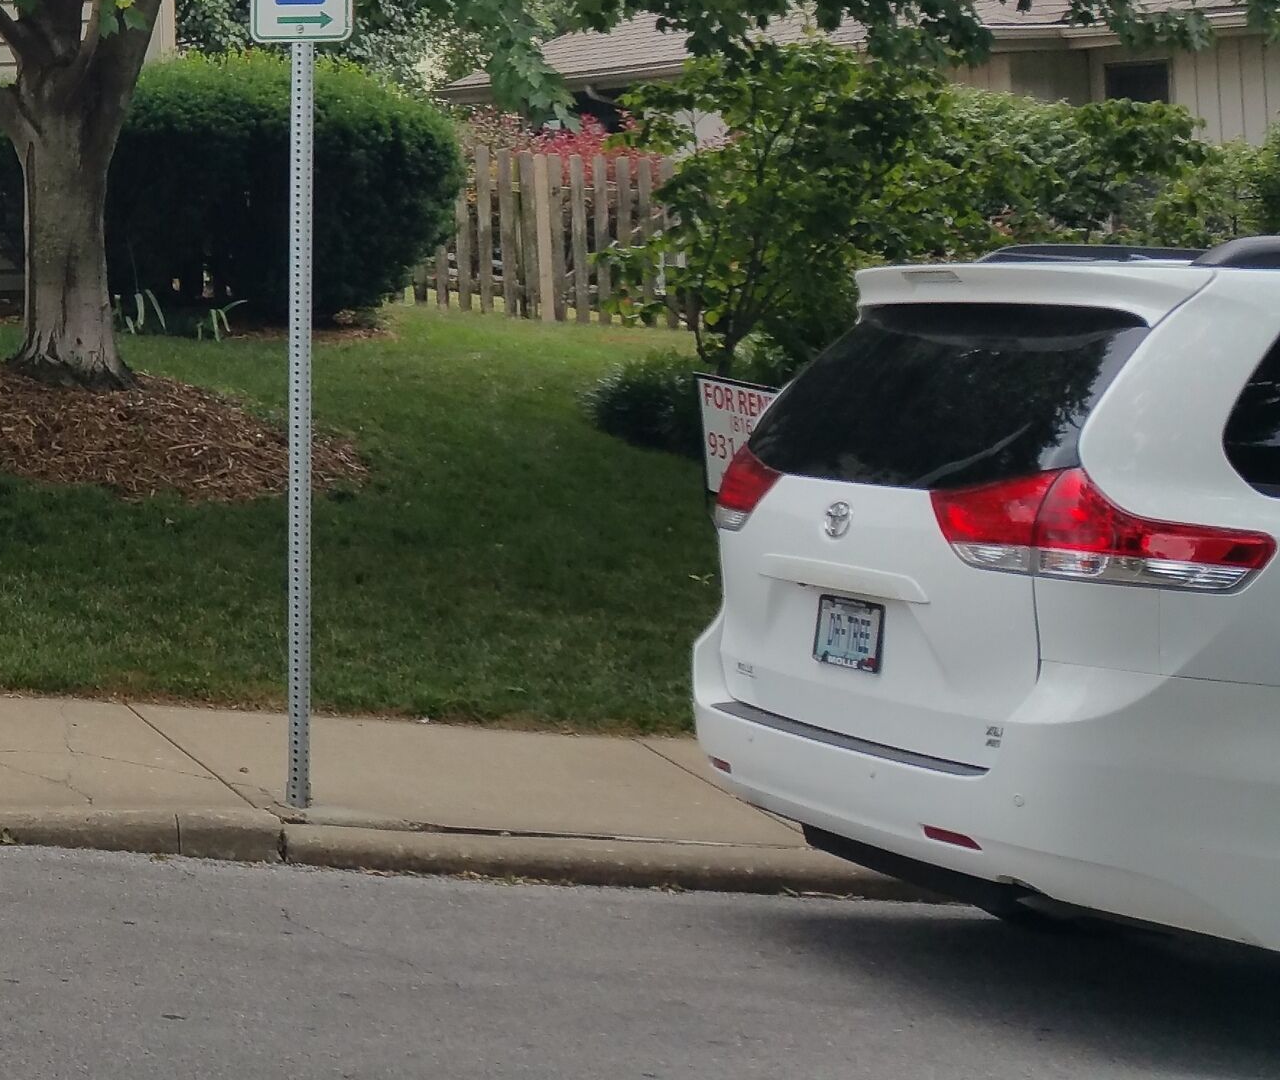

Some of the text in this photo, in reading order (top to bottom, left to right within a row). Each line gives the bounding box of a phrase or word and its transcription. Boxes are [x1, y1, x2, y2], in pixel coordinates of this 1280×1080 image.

[703, 382, 735, 413] FOR
[708, 431, 735, 460] 931
[827, 655, 859, 670] MOLLE
